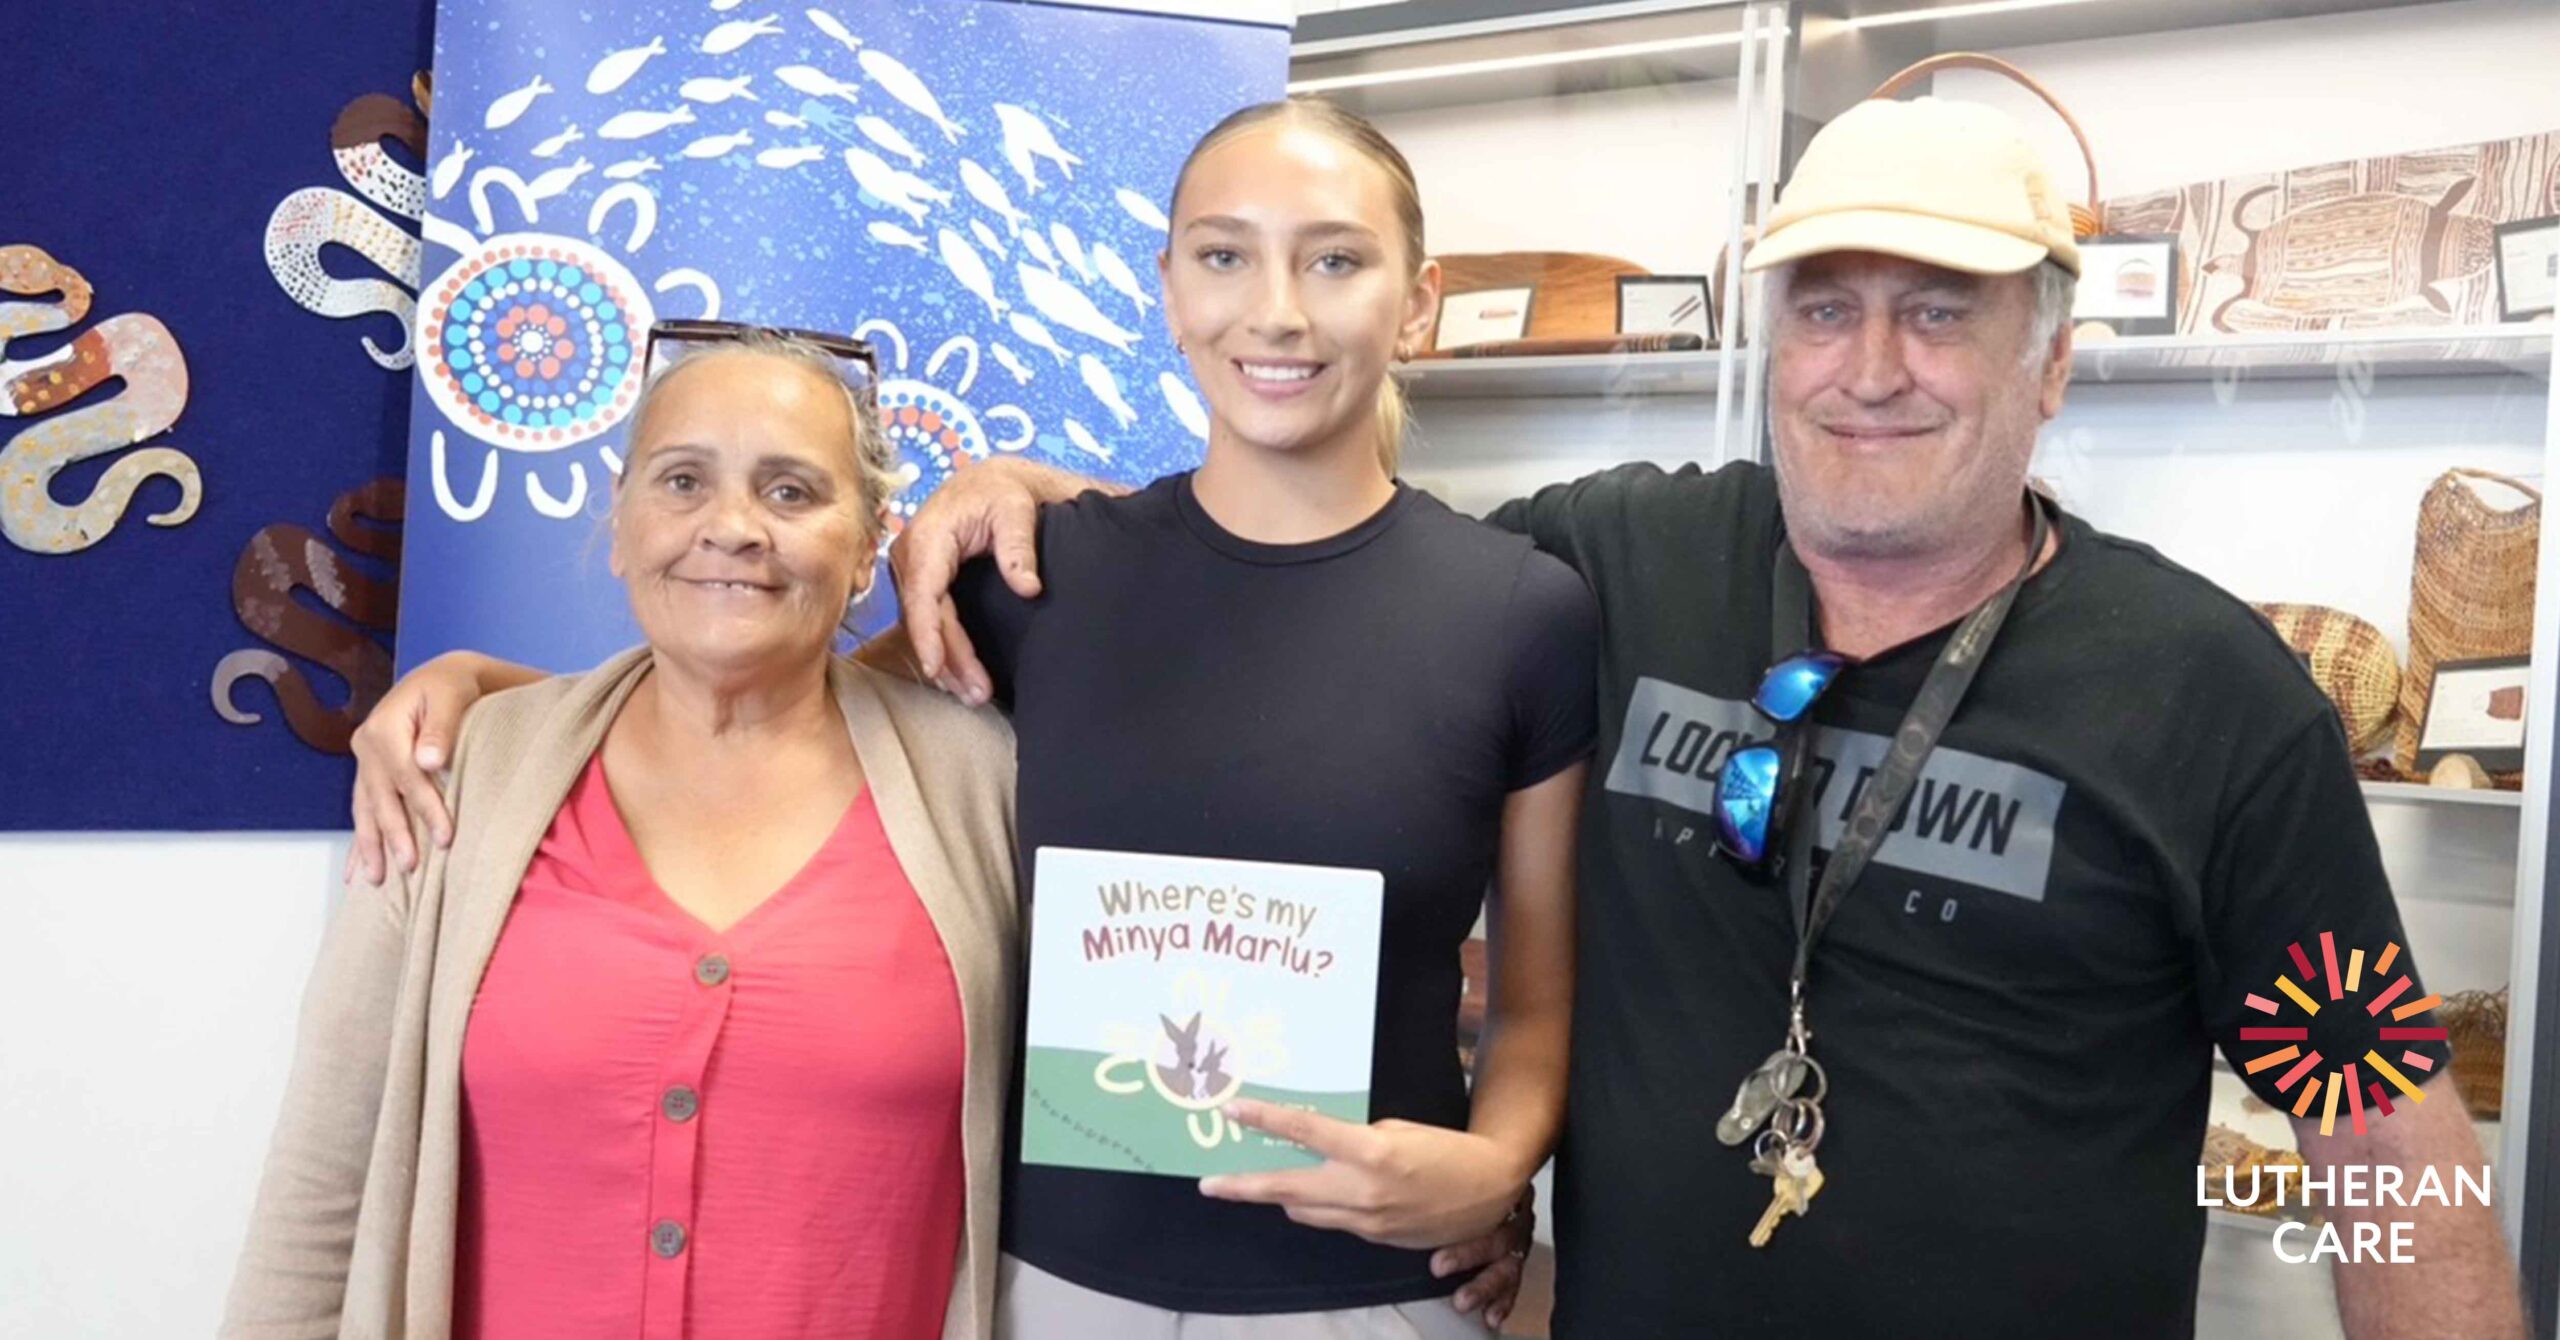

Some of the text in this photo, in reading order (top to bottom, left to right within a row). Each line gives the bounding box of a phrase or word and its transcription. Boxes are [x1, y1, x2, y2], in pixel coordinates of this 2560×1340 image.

[1098, 880, 1317, 938] Where's my
[1082, 919, 1334, 979] Minya Marlu?
